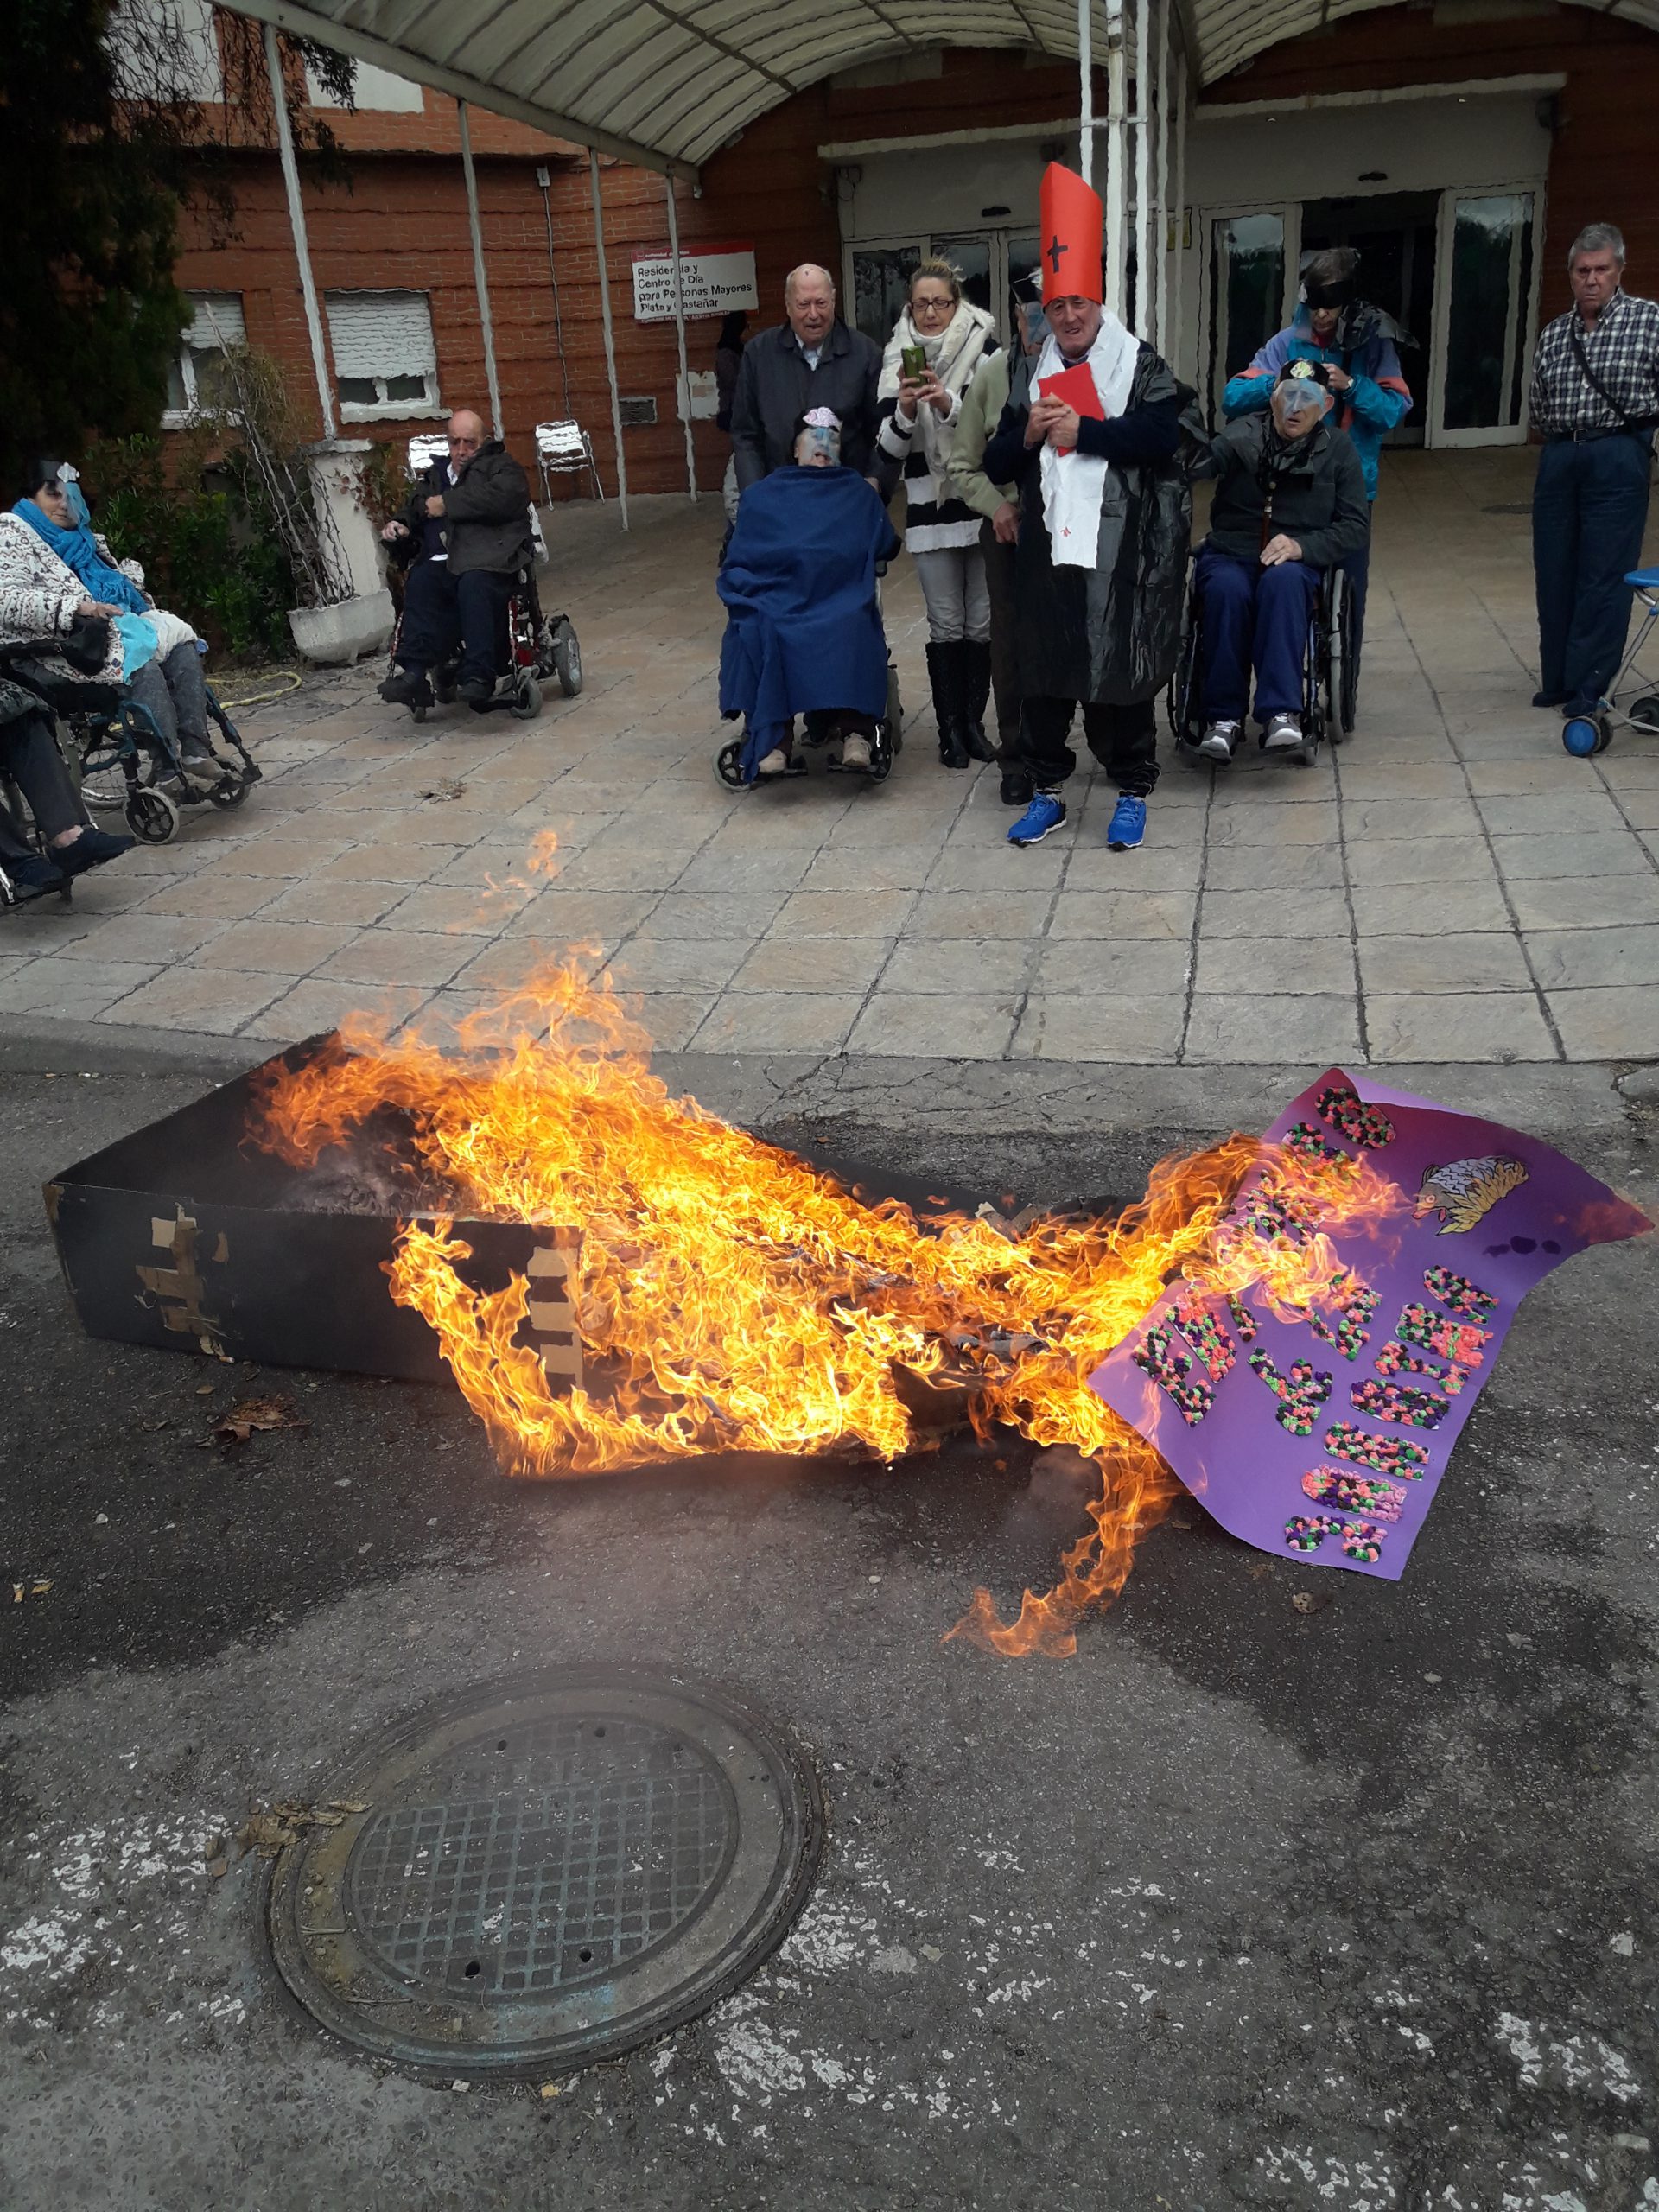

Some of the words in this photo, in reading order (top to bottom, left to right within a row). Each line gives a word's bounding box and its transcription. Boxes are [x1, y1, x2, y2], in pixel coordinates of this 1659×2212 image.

[638, 264, 690, 277] Residenia
[692, 264, 698, 274] y
[639, 278, 671, 289] Centro
[688, 275, 704, 284] Día
[639, 292, 660, 303] para
[663, 288, 709, 299] Pesonas
[711, 283, 753, 296] Mayores
[666, 303, 672, 312] y
[674, 299, 719, 309] astañar
[1133, 1087, 1396, 1427] ENERRO
[1284, 1264, 1499, 1562] SARDINA
